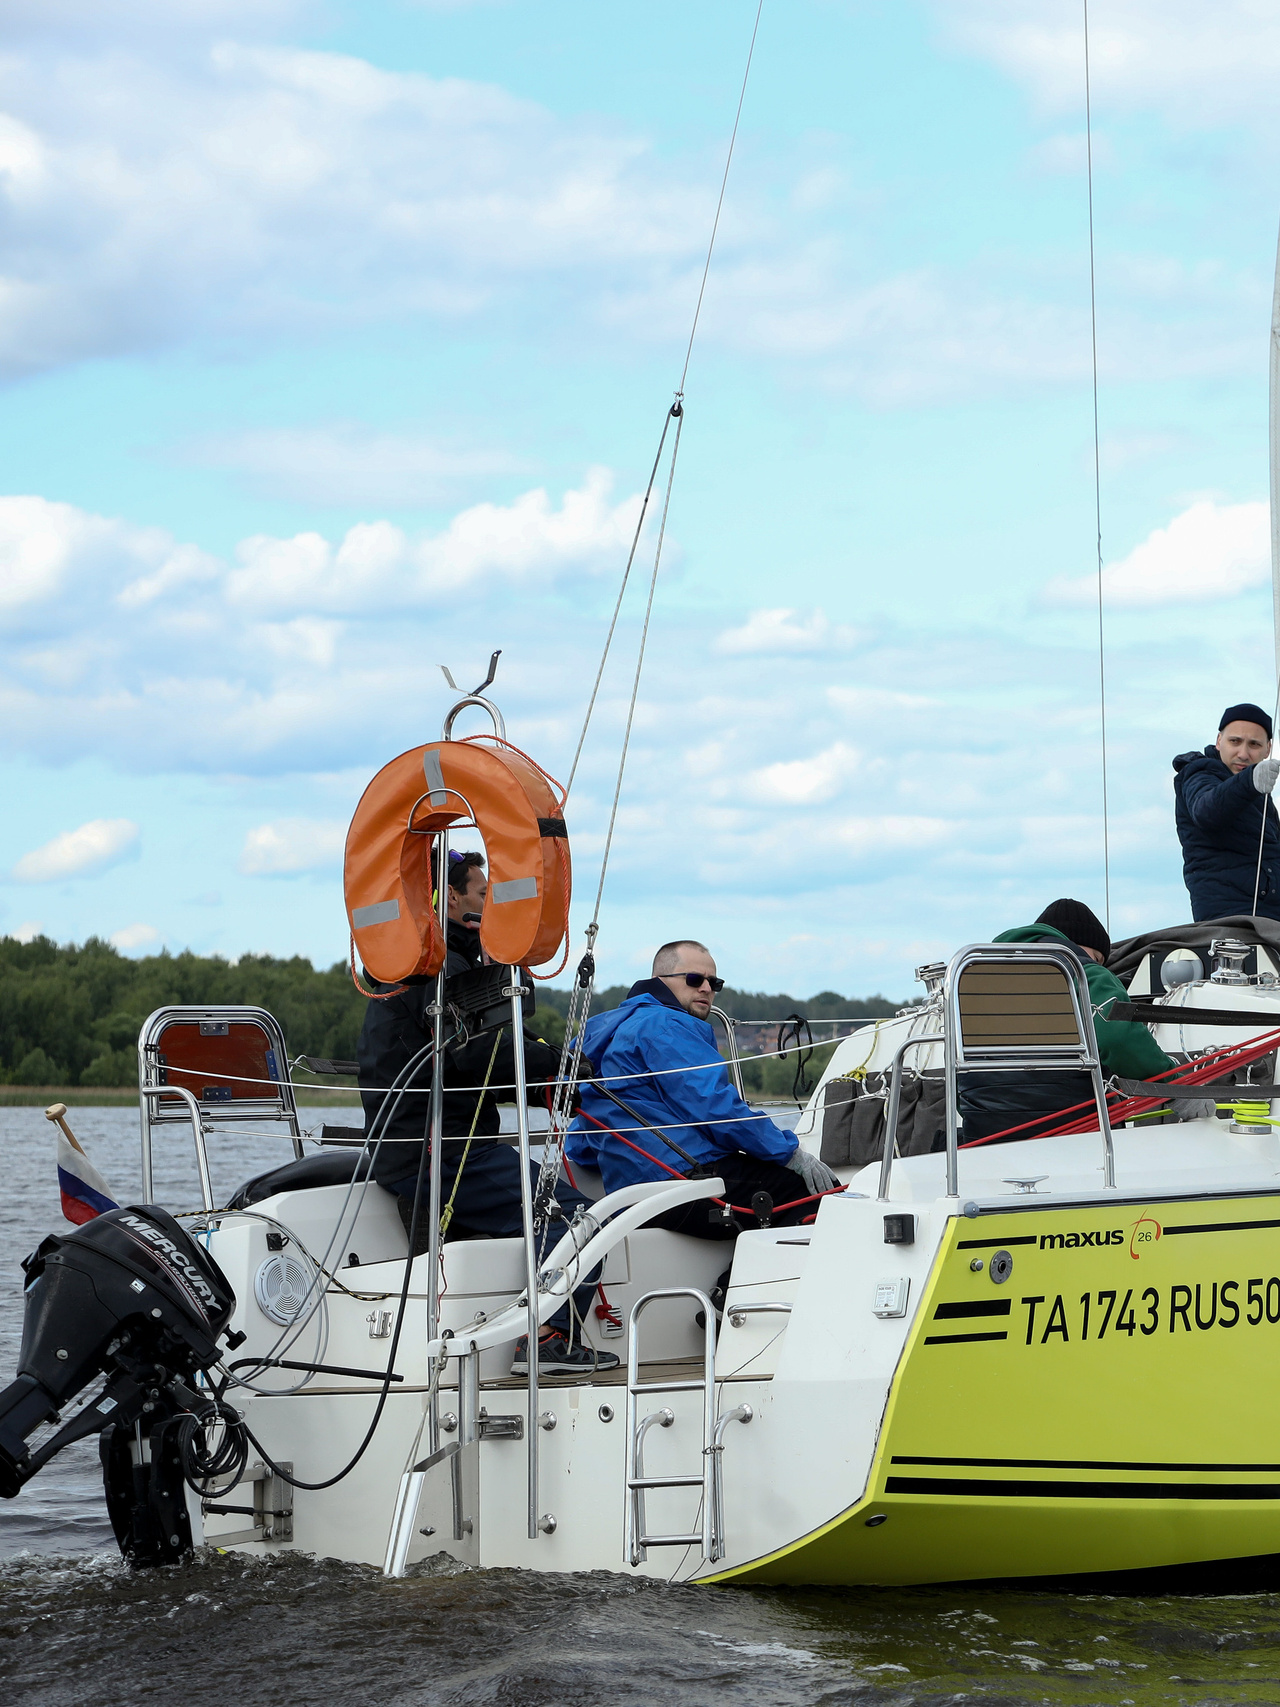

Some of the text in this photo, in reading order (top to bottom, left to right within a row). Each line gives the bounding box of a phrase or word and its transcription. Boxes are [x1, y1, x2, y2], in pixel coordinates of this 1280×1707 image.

[118, 1215, 223, 1312] MERCURY
[1039, 1229, 1152, 1250] maxus 26
[153, 1249, 209, 1316] FOURSTROKE
[1021, 1294, 1070, 1346] TA
[1079, 1286, 1160, 1341] 1743
[1168, 1280, 1241, 1334] RUS
